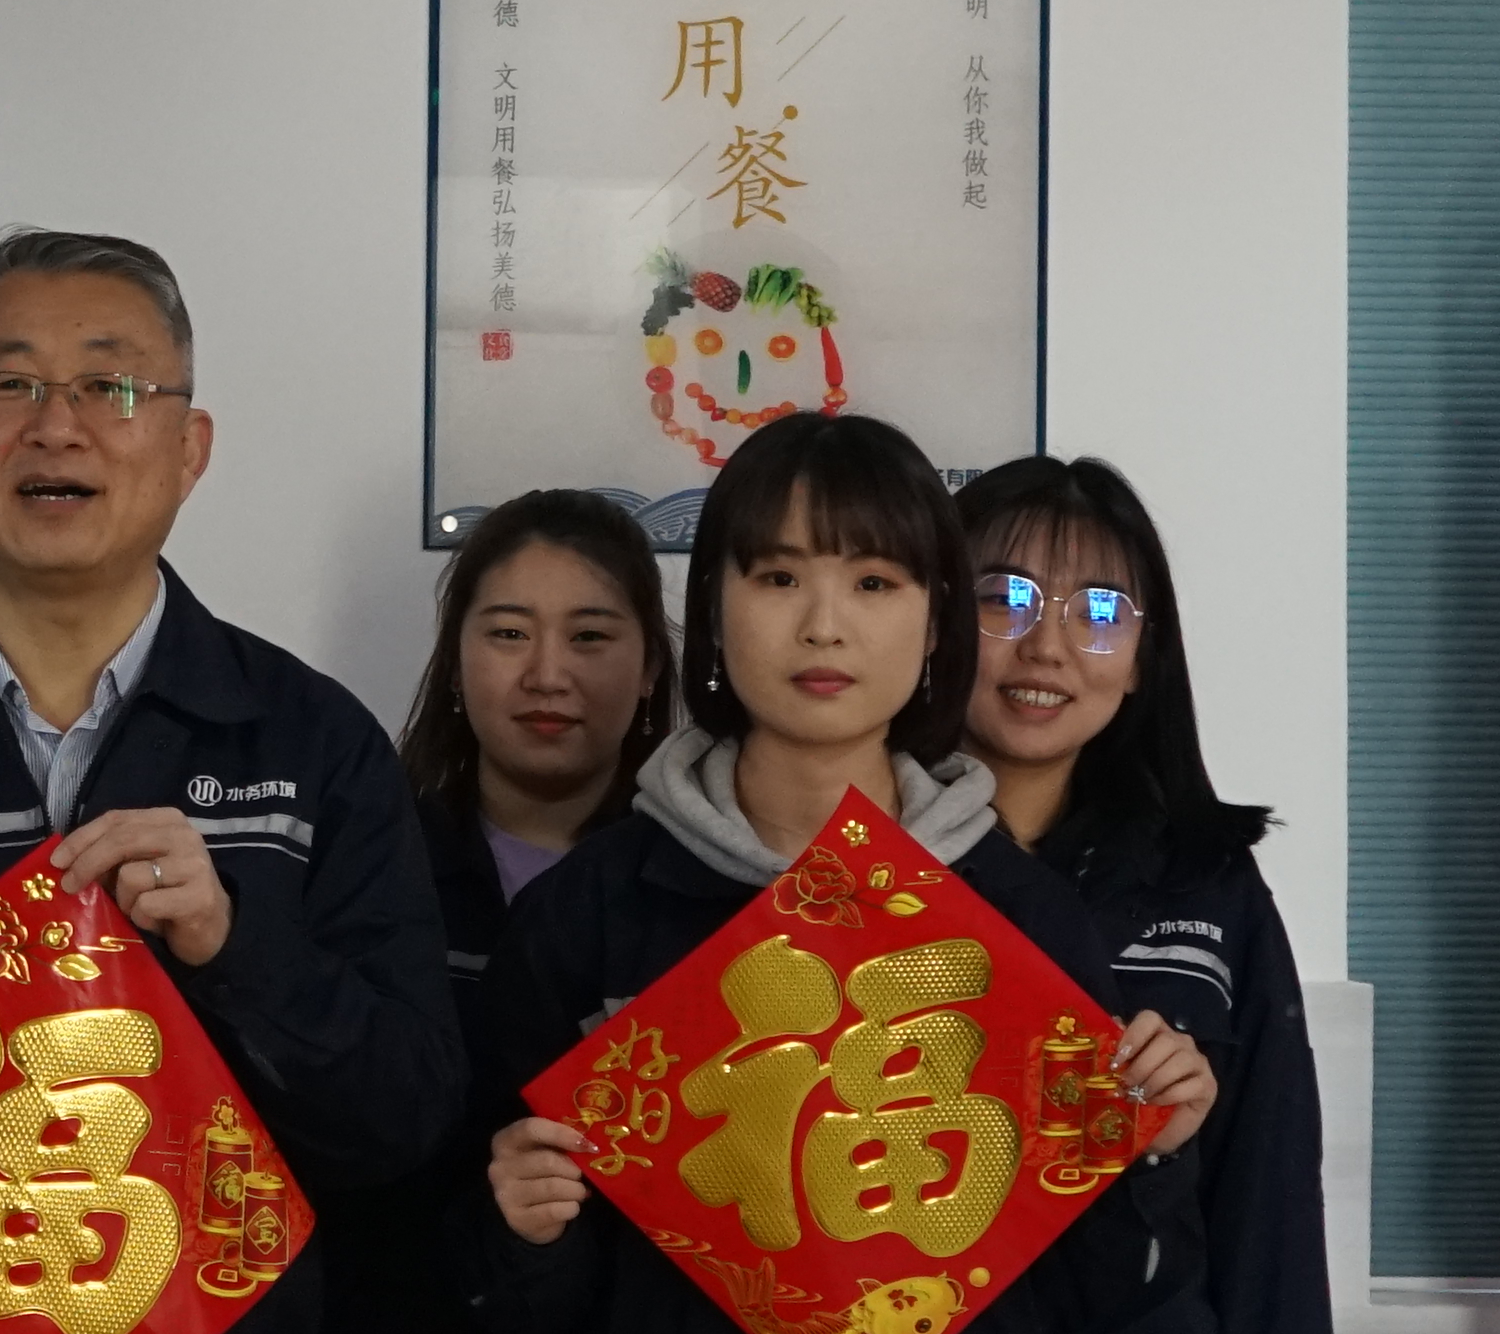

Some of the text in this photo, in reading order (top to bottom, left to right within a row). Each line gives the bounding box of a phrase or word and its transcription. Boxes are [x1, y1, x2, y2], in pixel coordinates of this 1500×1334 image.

[491, 63, 519, 312] 文明用餐弘扬美德
[962, 55, 990, 210] 从你我做起
[226, 780, 297, 802] 水务环境
[590, 1018, 681, 1176] 好日子
[679, 933, 1022, 1259] 福
[212, 1168, 245, 1203] 福
